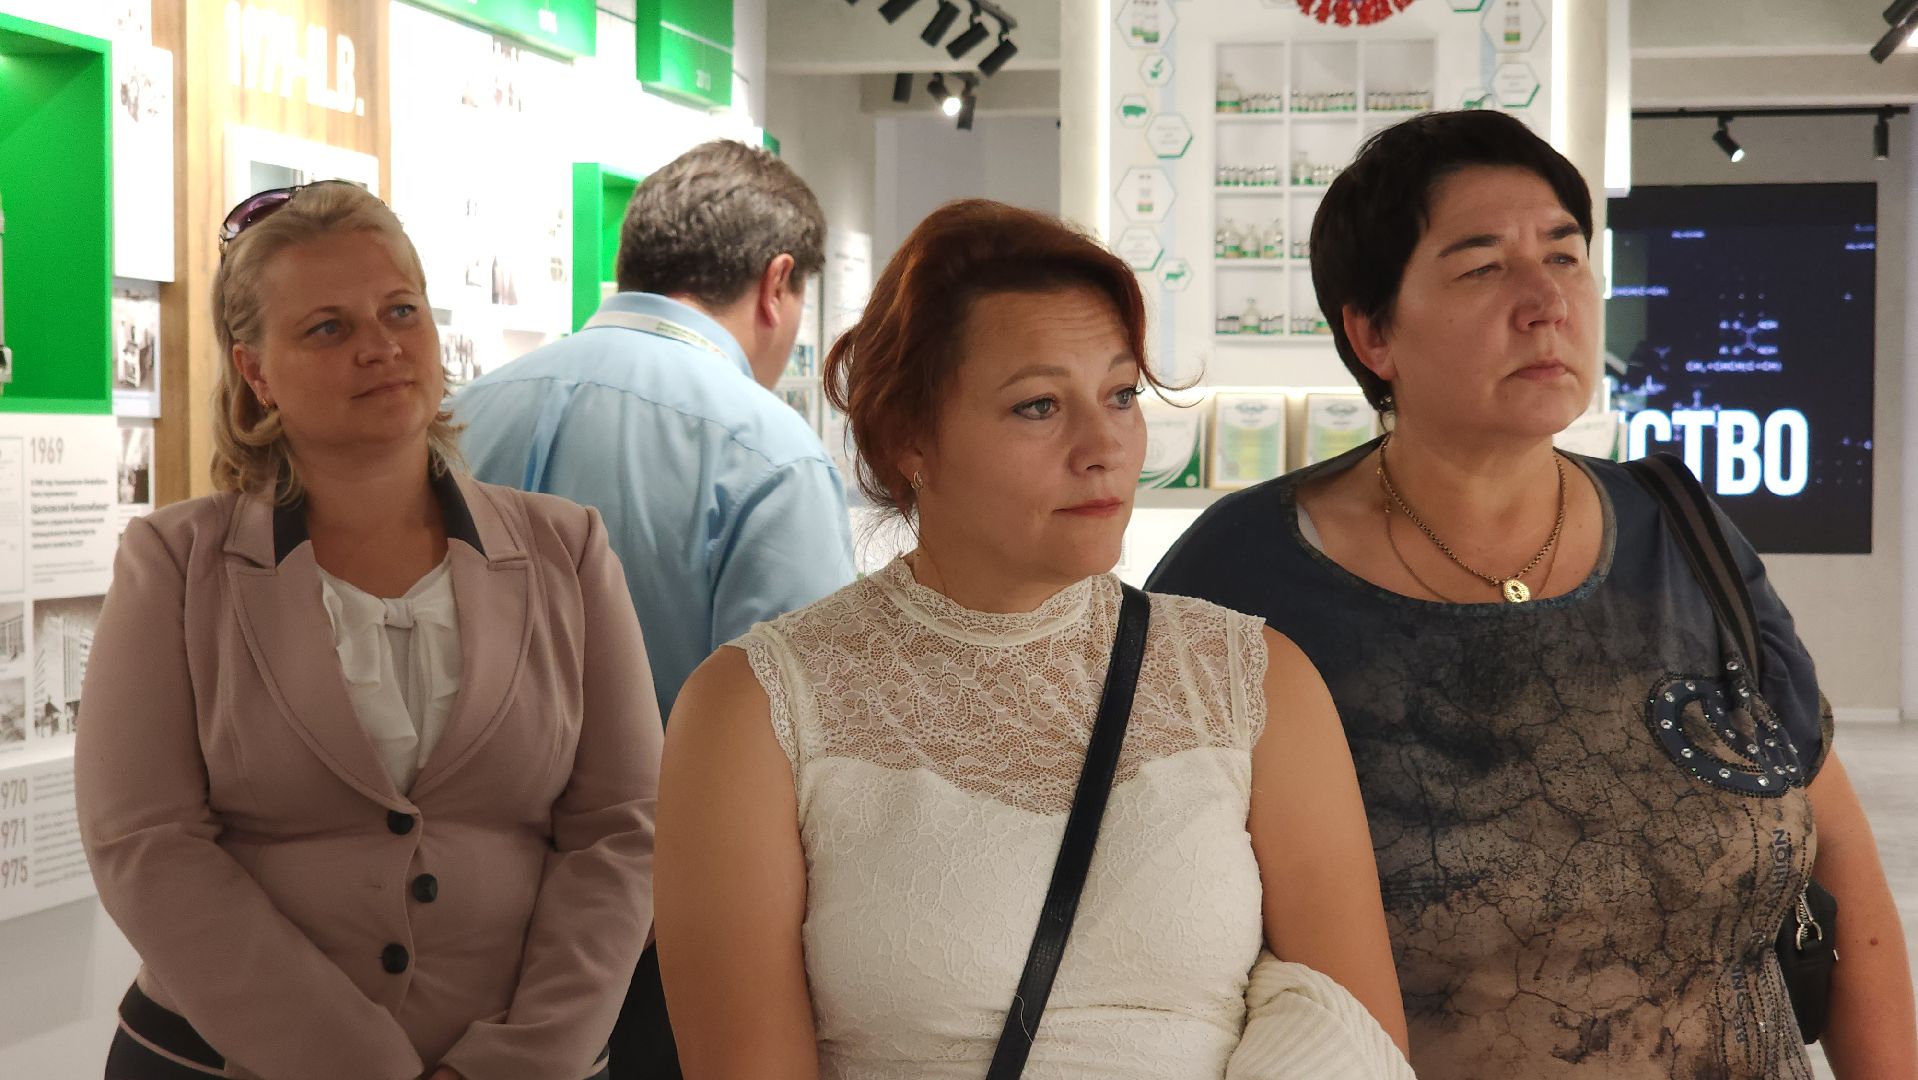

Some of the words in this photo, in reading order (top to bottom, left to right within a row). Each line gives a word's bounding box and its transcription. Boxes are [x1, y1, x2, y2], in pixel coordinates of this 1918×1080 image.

[31, 436, 64, 464] 1969
[1617, 409, 1809, 497] СТВО
[0, 778, 28, 810] 970
[0, 817, 27, 849] 971
[0, 856, 28, 888] 975
